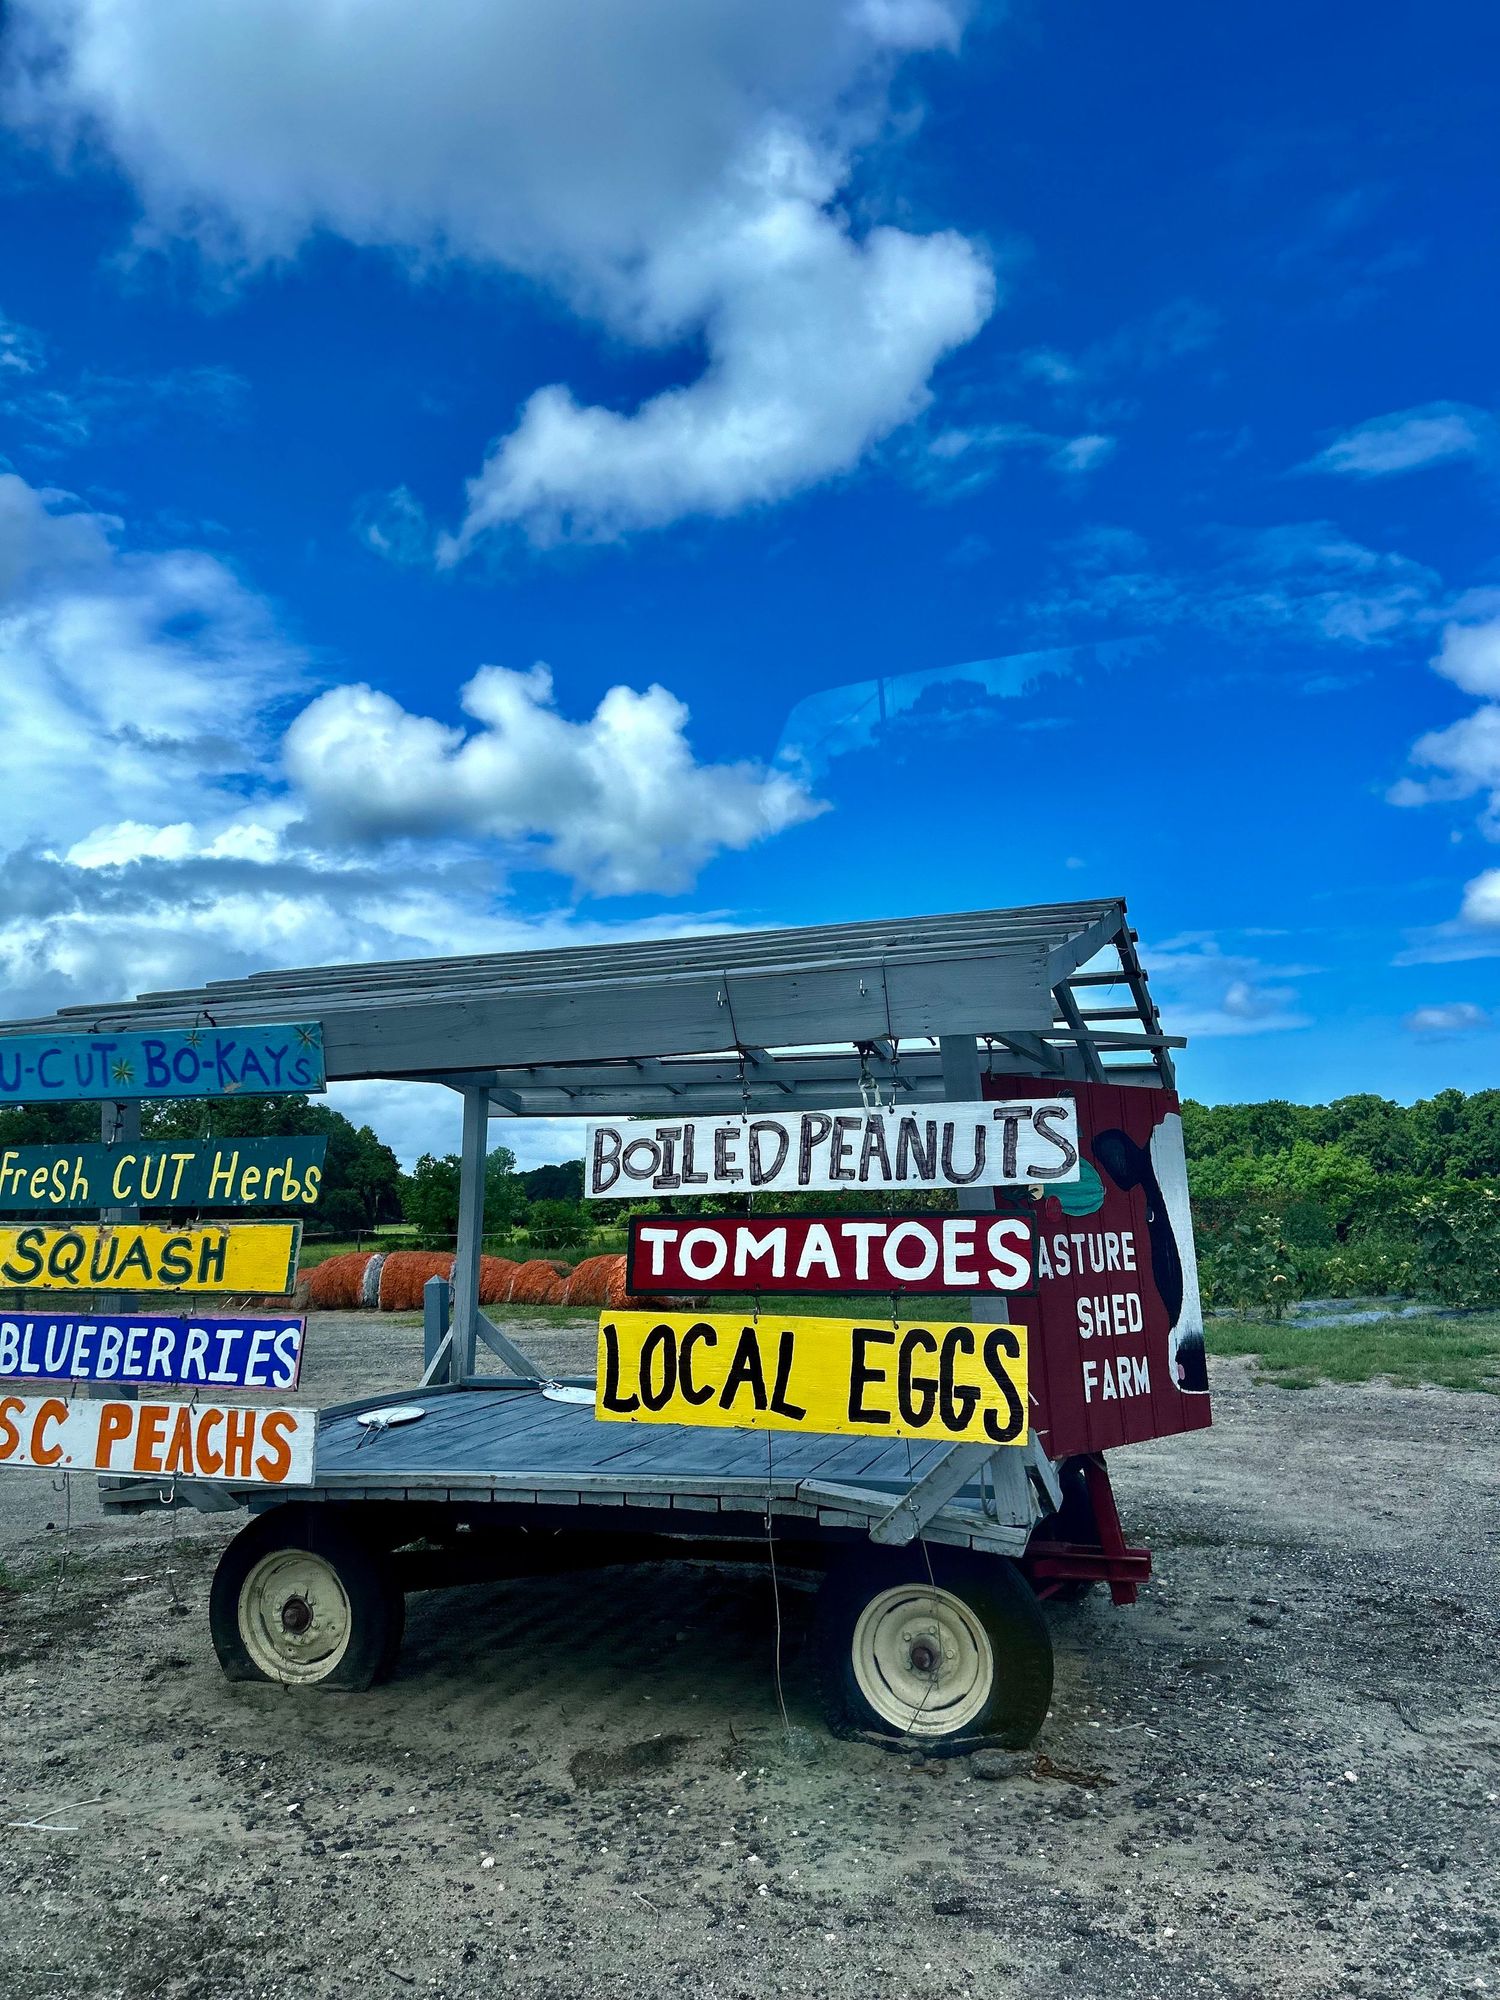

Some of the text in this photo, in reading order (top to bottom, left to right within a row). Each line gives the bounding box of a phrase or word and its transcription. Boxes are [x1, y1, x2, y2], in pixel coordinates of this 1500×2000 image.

[0, 1043, 117, 1092] U-CUT
[592, 1105, 1077, 1193] BOILED PEANUTS
[112, 1154, 195, 1200] CUT
[207, 1151, 322, 1204] Herbs
[1, 1228, 228, 1284] SQUASH
[640, 1218, 1031, 1290] TOMATOES
[1038, 1231, 1137, 1280] ASTURE
[1076, 1293, 1143, 1339] SHED
[0, 1322, 301, 1388] BLUEBERRIES
[601, 1322, 1024, 1443] LOCAL EGGS
[1082, 1356, 1151, 1403] FARM
[0, 1396, 298, 1483] S.C. PEACHS
